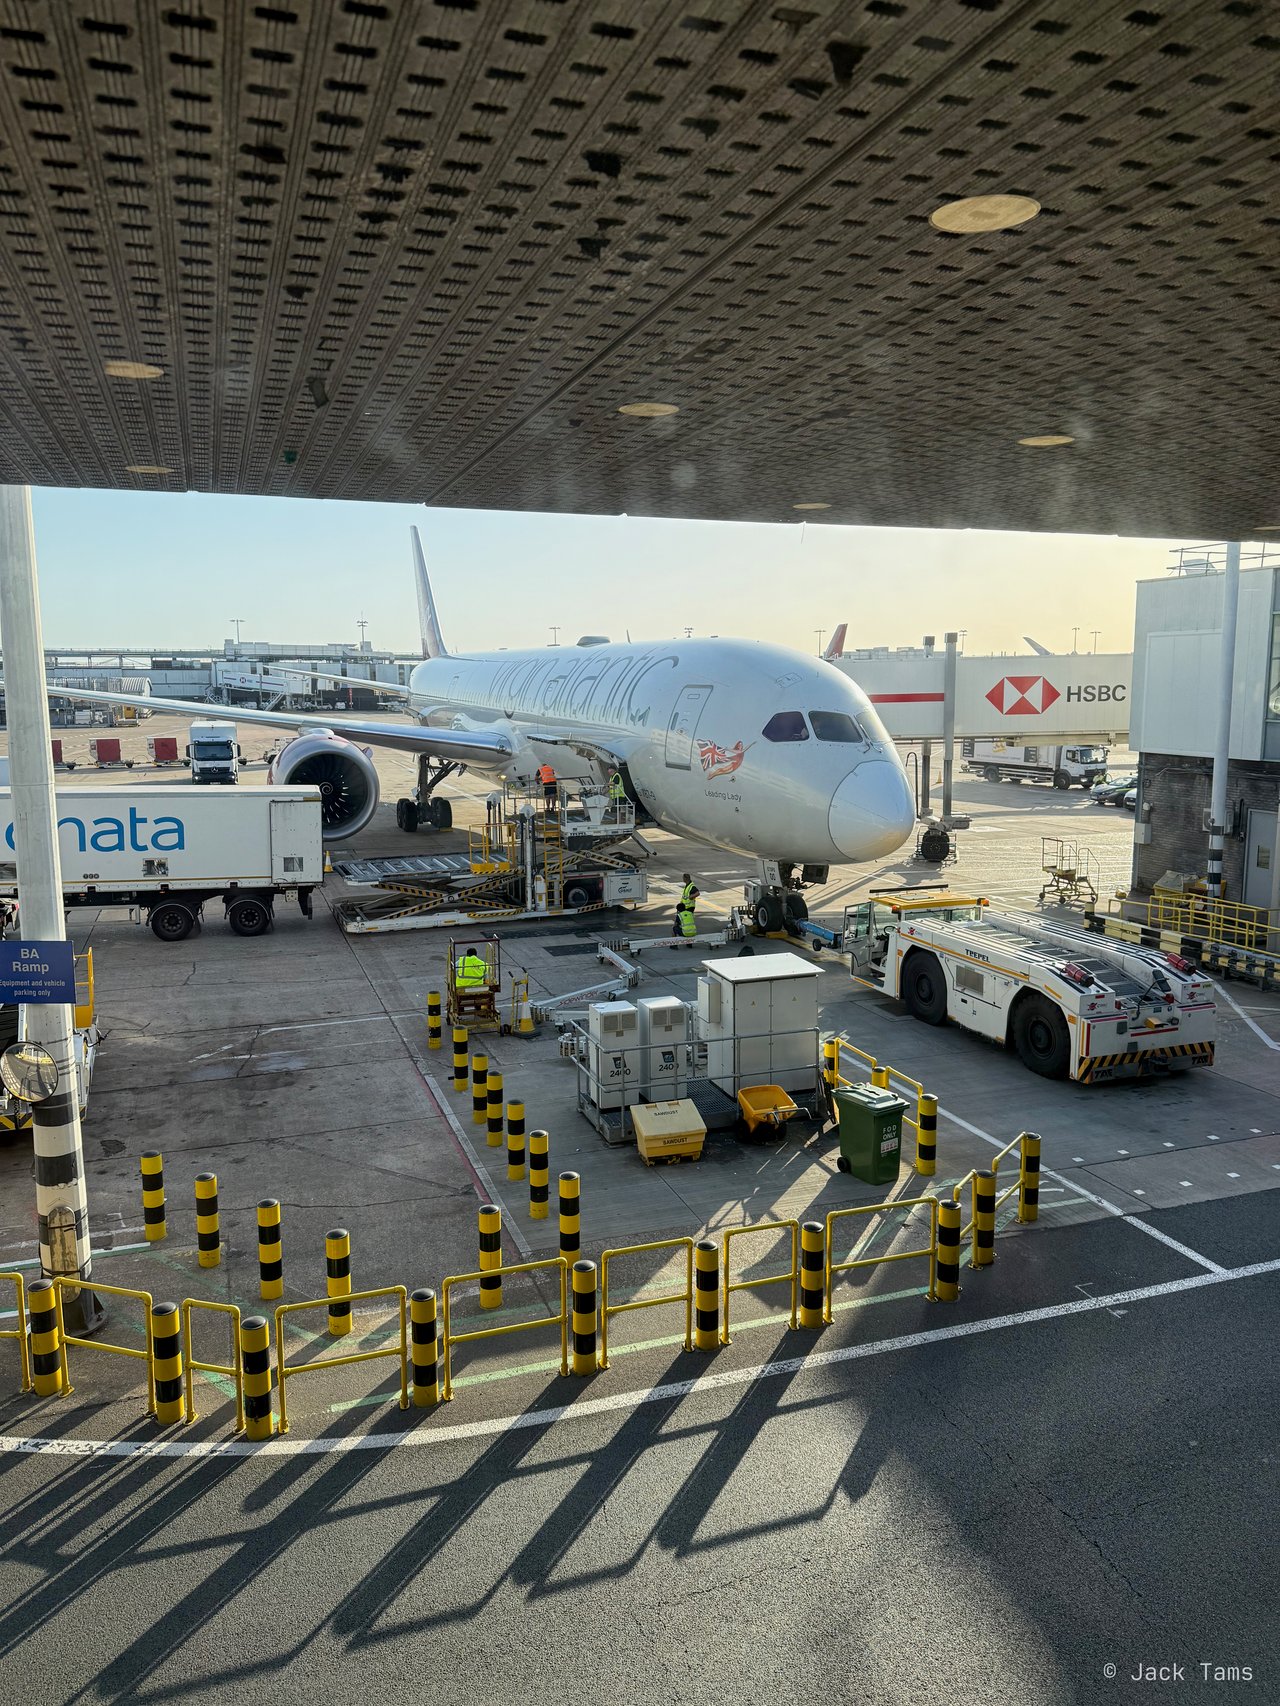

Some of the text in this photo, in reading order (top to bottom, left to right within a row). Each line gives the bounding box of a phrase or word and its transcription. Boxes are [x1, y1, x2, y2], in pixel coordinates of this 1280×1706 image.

[1066, 684, 1127, 702] HSBC
[704, 789, 742, 802] Leading Lady
[5, 806, 185, 852] nata
[20, 948, 40, 959] BA
[12, 961, 49, 974] Ramp
[14, 989, 51, 997] parking only
[653, 1109, 678, 1117] SAWDUST
[883, 1130, 897, 1141] ONLY
[662, 1137, 688, 1146] SAWDUST
